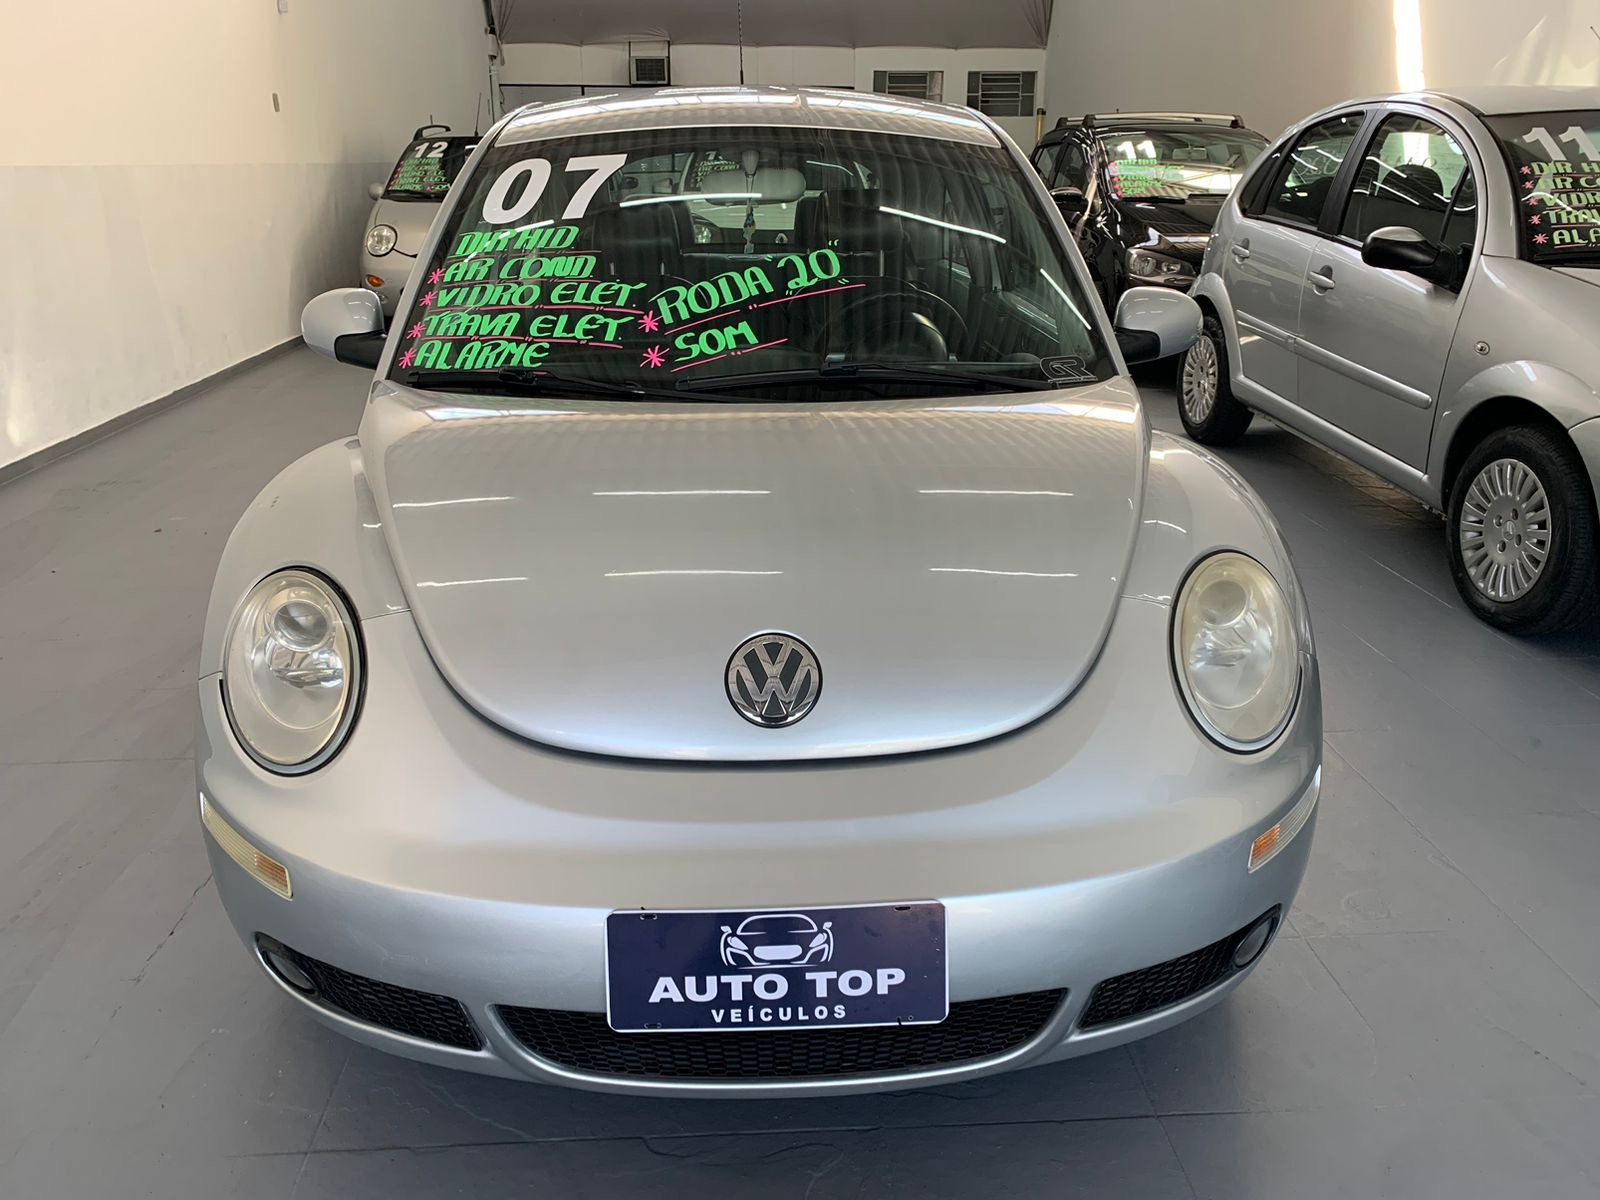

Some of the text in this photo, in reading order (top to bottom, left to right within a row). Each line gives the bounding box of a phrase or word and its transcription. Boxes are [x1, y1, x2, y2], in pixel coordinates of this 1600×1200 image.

[415, 141, 448, 158] 12
[1117, 140, 1156, 160] 11
[1522, 126, 1600, 161] 11
[482, 153, 628, 225] 07
[442, 256, 495, 283] AR
[436, 283, 541, 307] VIDRO
[648, 266, 774, 325] RODA
[423, 312, 521, 337] TRAVA
[413, 340, 550, 370] ALARME
[674, 320, 759, 362] SOM
[648, 967, 906, 1003] AUTO TOP
[711, 1004, 847, 1023] VEÍCULOS
